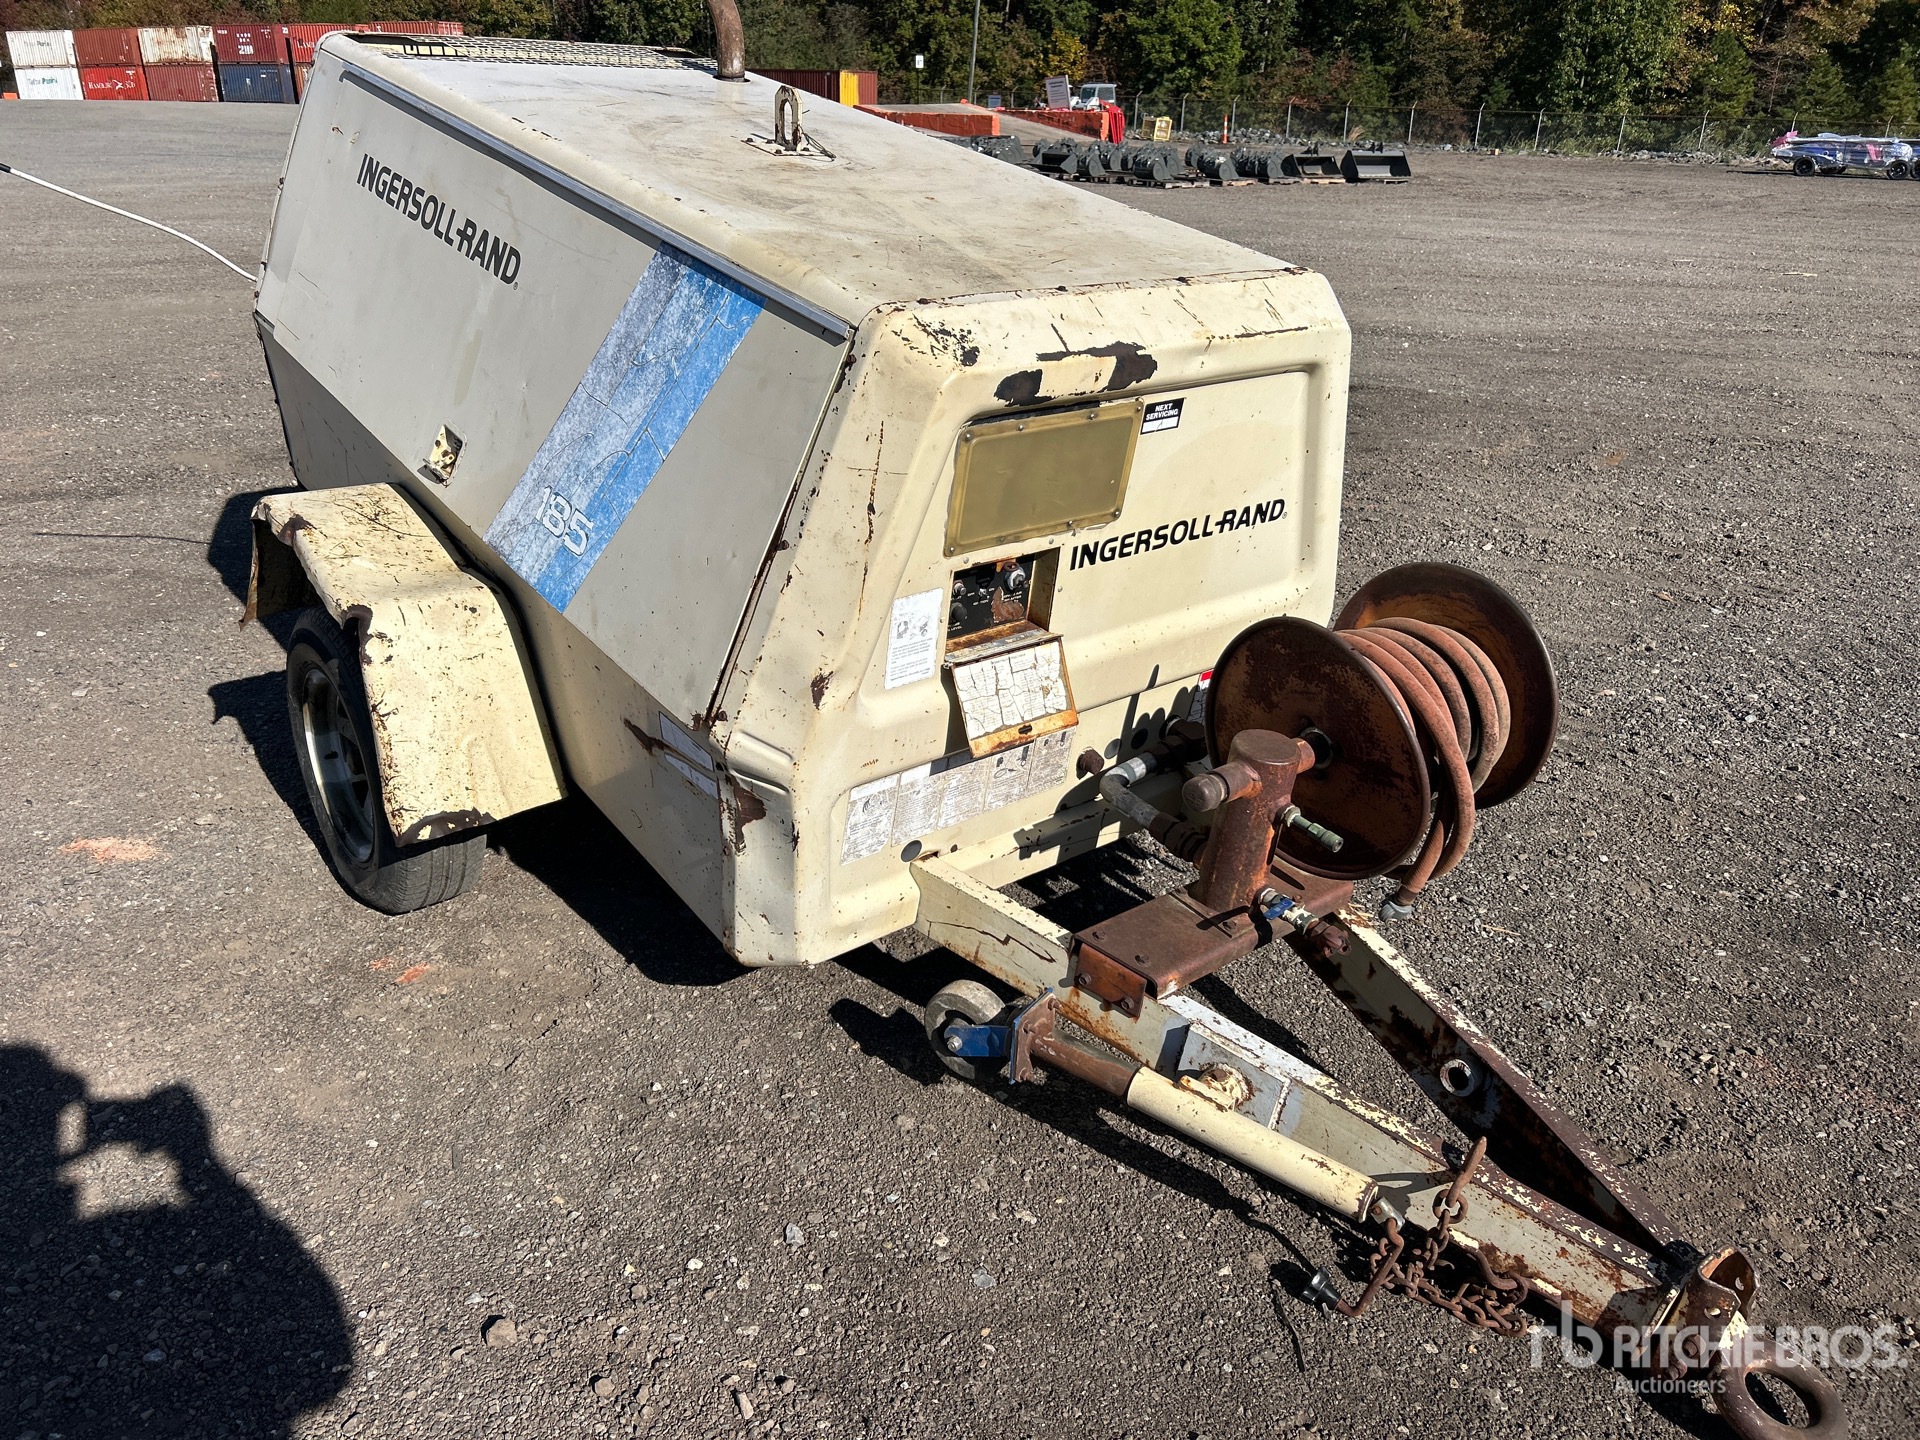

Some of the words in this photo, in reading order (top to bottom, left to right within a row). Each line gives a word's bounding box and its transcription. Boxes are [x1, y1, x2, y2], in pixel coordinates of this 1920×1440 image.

[357, 153, 521, 285] INGERSOLL-RAND
[1146, 409, 1179, 421] SERVICING
[1155, 403, 1173, 412] NEXT
[536, 485, 594, 557] 185
[1069, 499, 1286, 571] INGERSOLL-RAND
